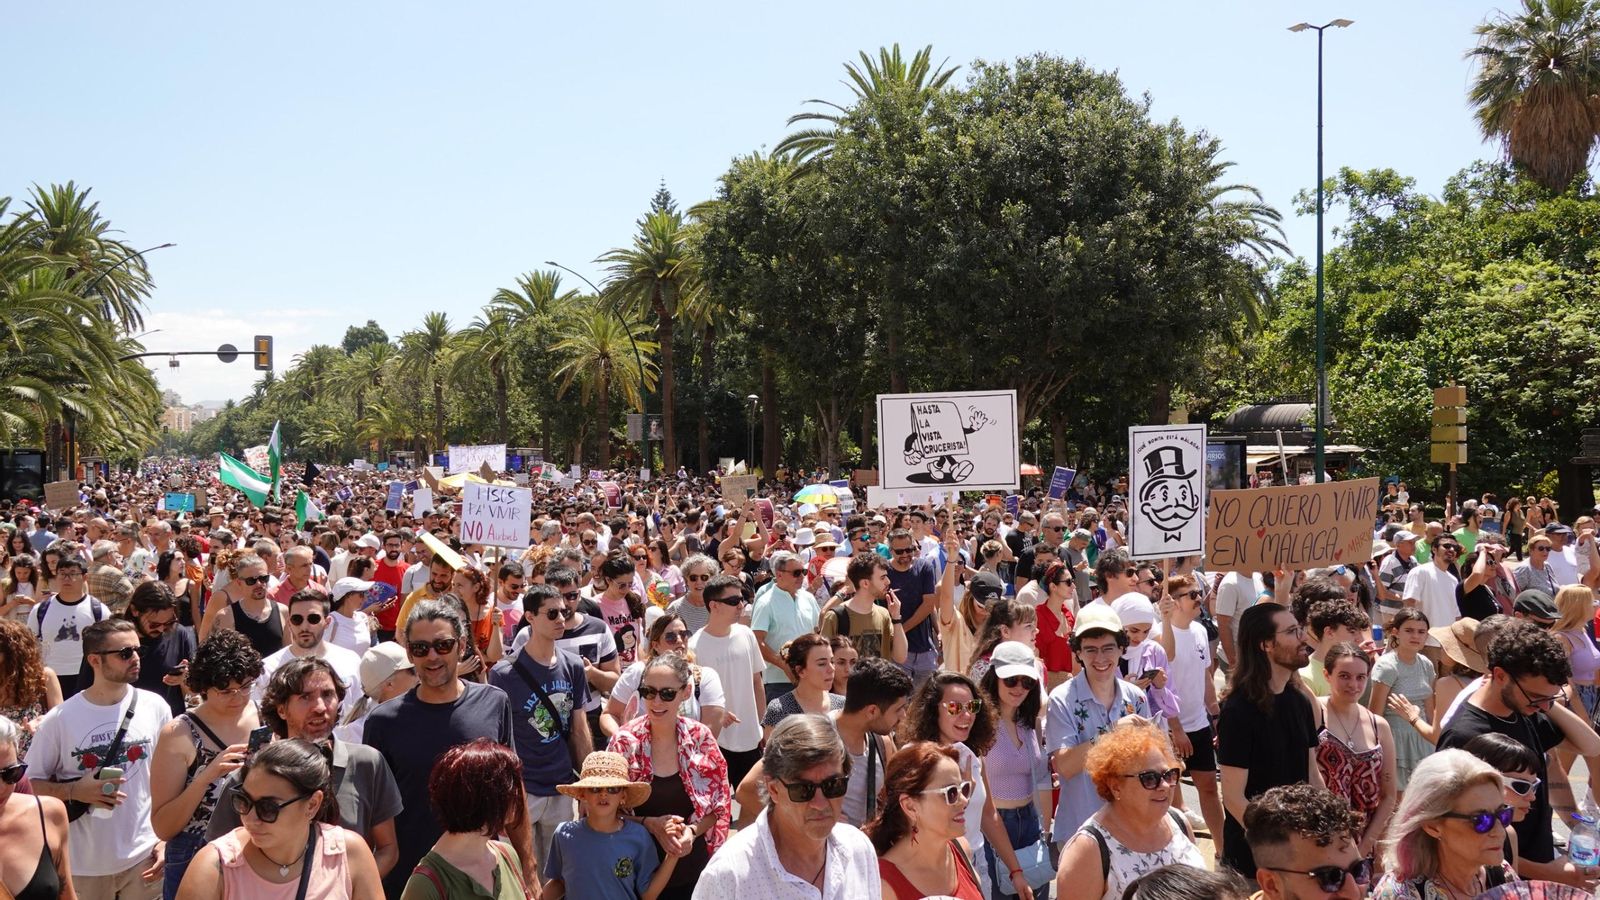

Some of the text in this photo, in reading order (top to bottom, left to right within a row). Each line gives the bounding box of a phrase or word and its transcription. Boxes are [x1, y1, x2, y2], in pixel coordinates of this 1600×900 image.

[916, 404, 941, 415] HASTA
[919, 418, 930, 428] LA
[921, 430, 942, 442] VISTA
[924, 441, 966, 454] CRUCERISTA!
[489, 505, 521, 520] VIVIR
[1214, 485, 1376, 530] YO QUIERO VIVIR
[462, 520, 483, 541] NO
[1211, 535, 1249, 567] EN
